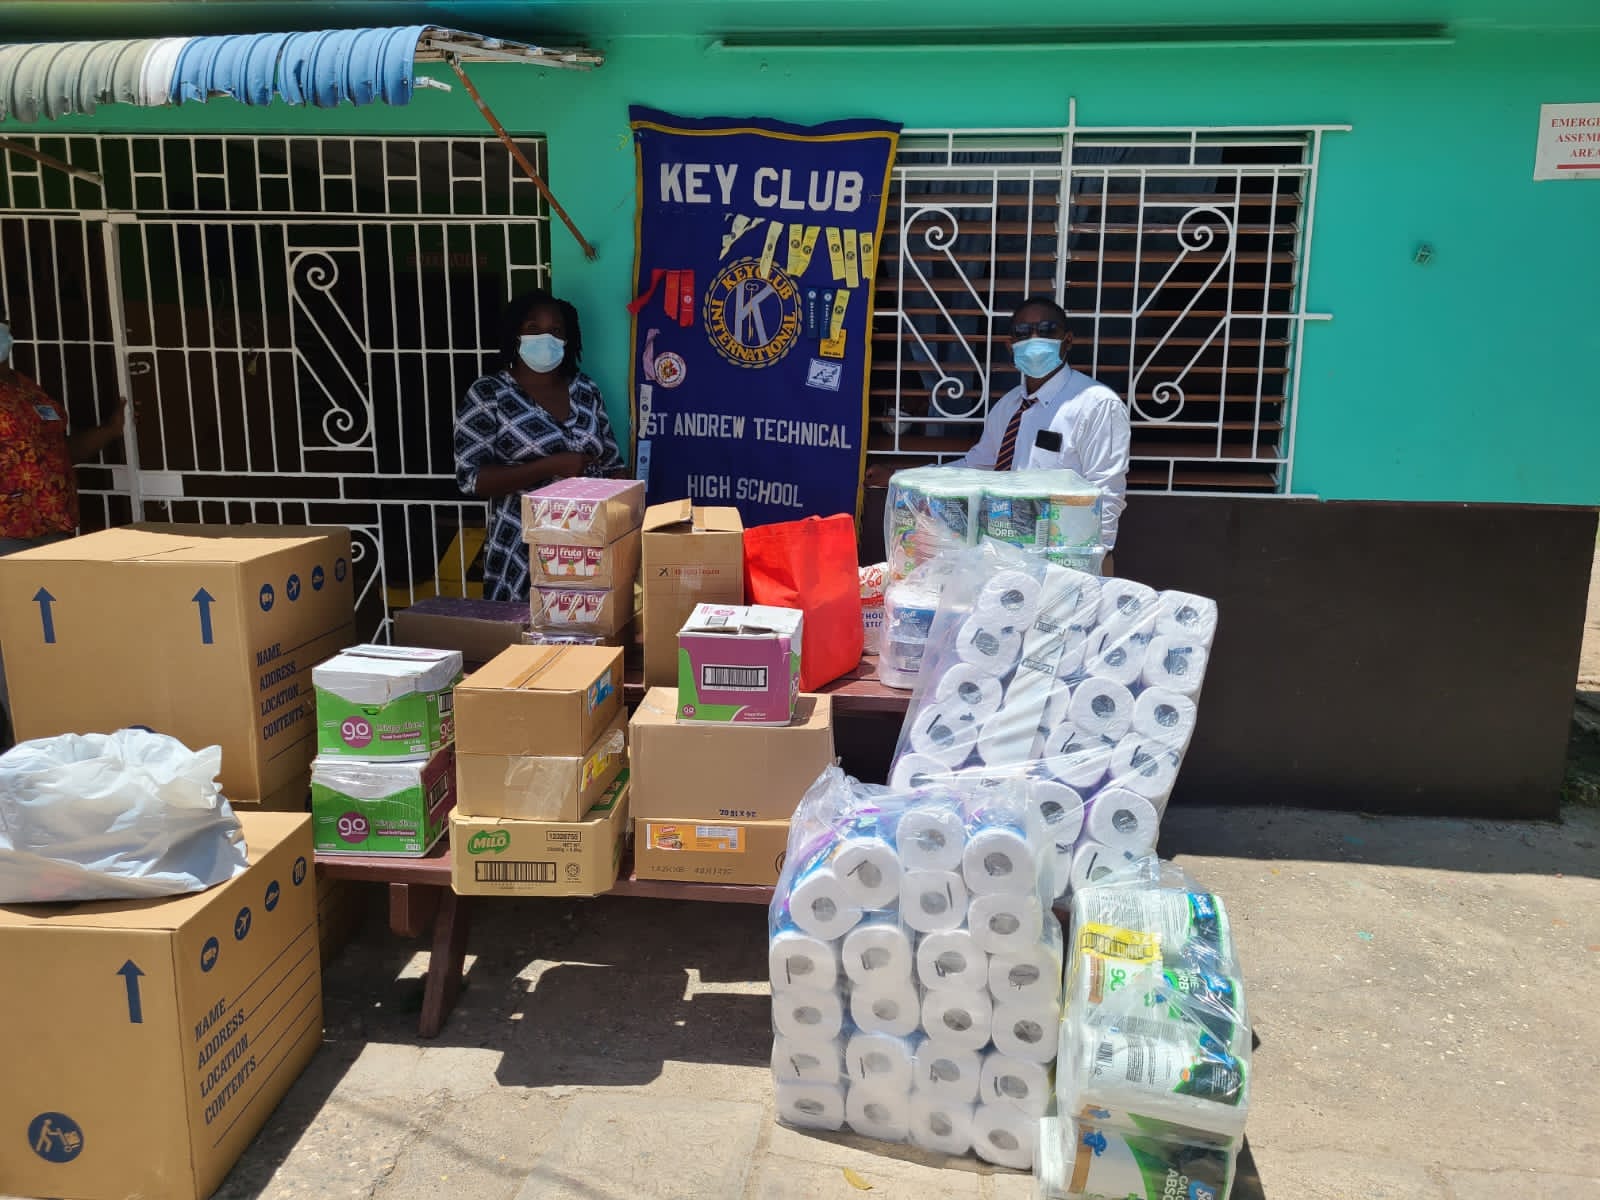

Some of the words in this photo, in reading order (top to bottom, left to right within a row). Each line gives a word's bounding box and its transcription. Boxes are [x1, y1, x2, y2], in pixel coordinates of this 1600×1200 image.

[660, 163, 738, 205] KEY
[753, 166, 864, 212] CLUB
[721, 265, 755, 292] KEY
[711, 298, 797, 361] INTERNATIONAL
[645, 412, 668, 436] ST
[673, 412, 745, 440] ANDREW
[753, 416, 852, 449] TECHNICAL
[687, 474, 731, 499] HIGH
[735, 476, 803, 508] SCHOOL
[256, 643, 282, 667] NAME
[259, 660, 297, 692] ADDRESS
[261, 682, 300, 717] LOCATION
[263, 705, 305, 741] CONTENTS
[342, 721, 369, 741] go
[338, 817, 366, 837] go
[472, 835, 507, 849] MILO
[194, 996, 227, 1043] NAME
[197, 1008, 246, 1070] ADDRESS
[199, 1033, 250, 1098] LOCATION
[204, 1056, 257, 1126] CONTENTS
